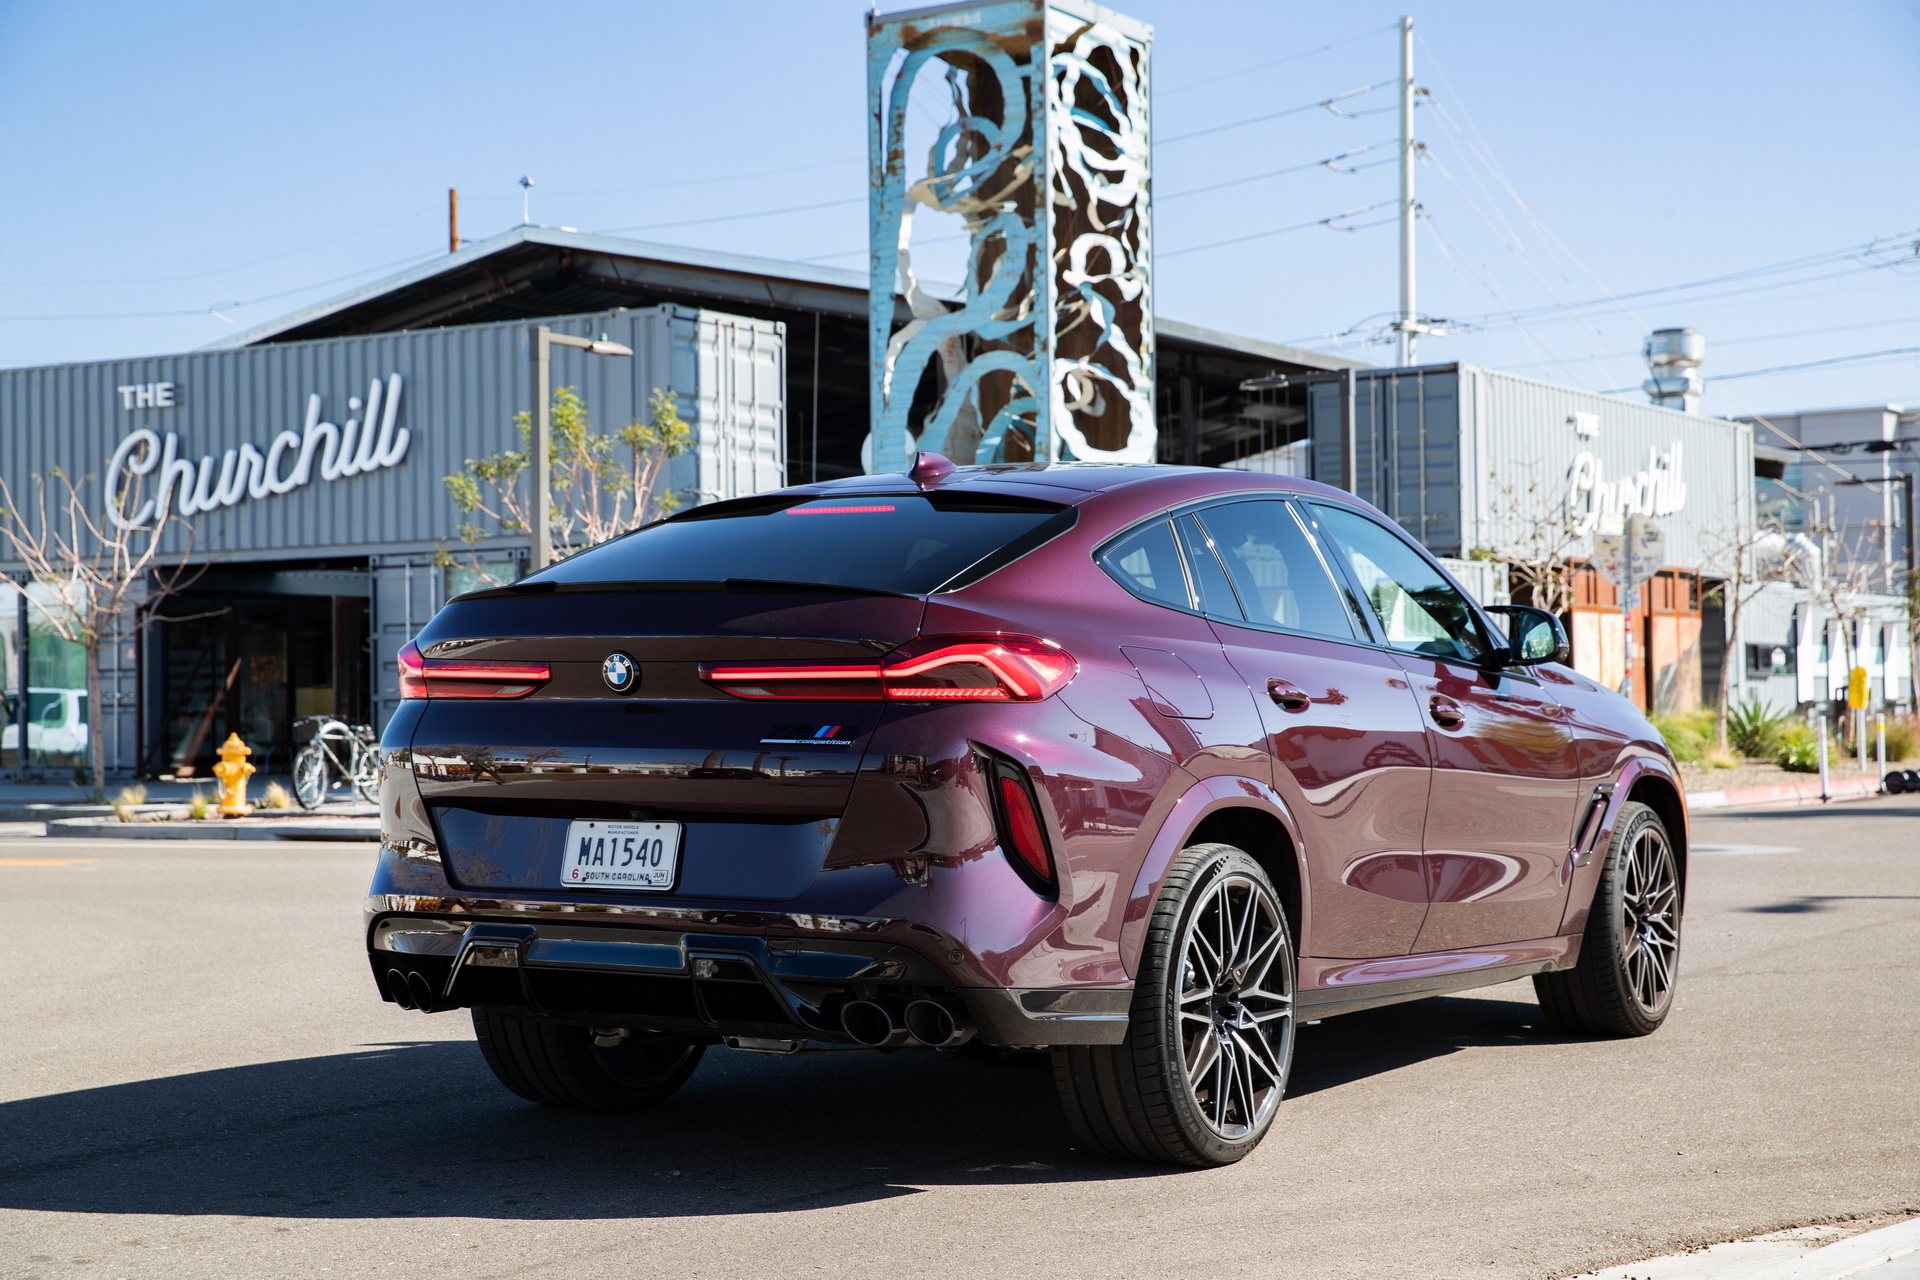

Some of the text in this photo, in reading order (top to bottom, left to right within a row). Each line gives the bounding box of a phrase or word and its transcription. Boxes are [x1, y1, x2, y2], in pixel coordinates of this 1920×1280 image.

[117, 382, 175, 410] THE
[1575, 412, 1600, 436] THE
[104, 372, 410, 530] Churchill
[1570, 440, 1687, 537] Churchill
[603, 655, 630, 671] BMW
[578, 837, 663, 867] MA1540
[572, 868, 579, 879] 6
[585, 871, 650, 881] SOUTH CAROLINA
[653, 871, 665, 879] JUN
